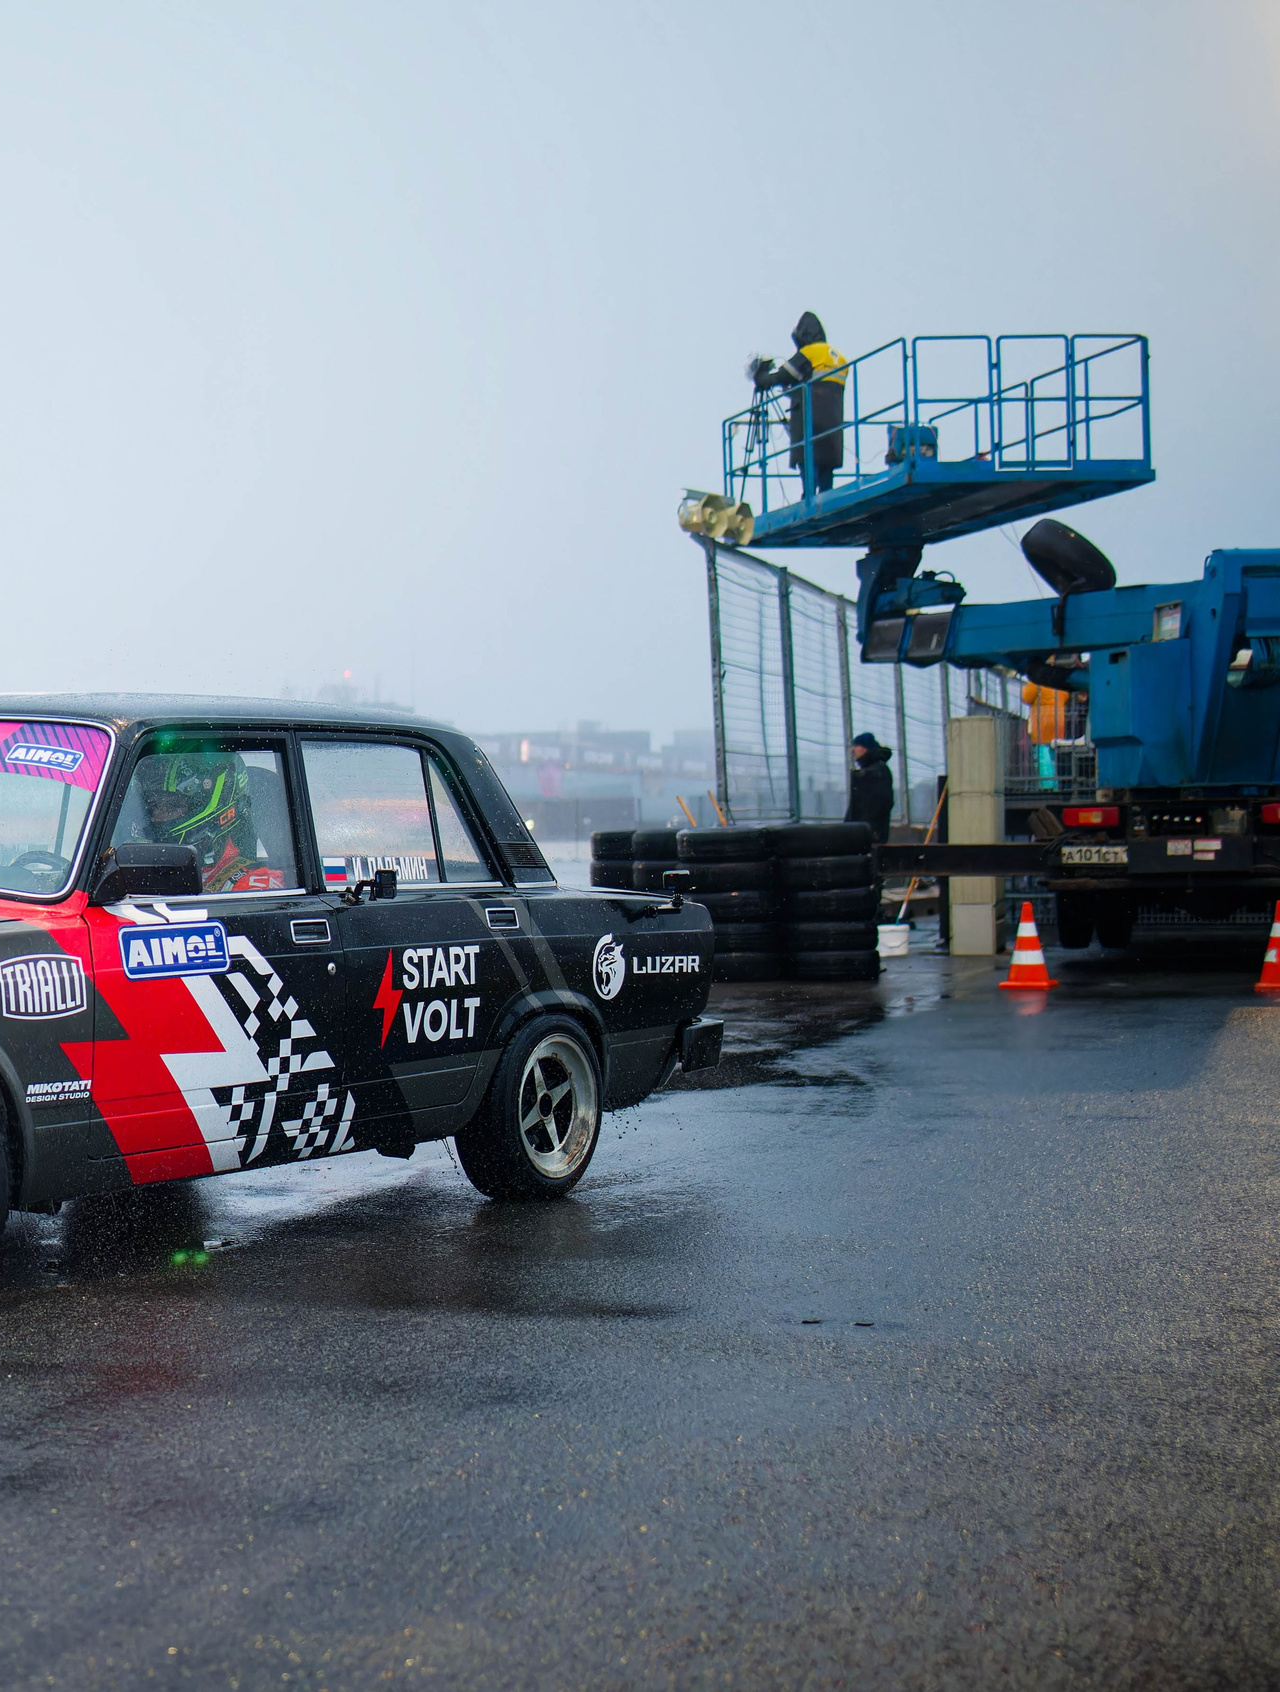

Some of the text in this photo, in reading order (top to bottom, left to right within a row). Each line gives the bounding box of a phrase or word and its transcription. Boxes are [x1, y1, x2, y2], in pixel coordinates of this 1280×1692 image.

[9, 748, 74, 768] AIMOL
[128, 935, 224, 968] AIMOL
[633, 955, 700, 974] LUZAR
[402, 945, 480, 990] START
[3, 960, 81, 1013] TRIALLI
[402, 997, 480, 1043] VOLT
[25, 1091, 89, 1103] DESIGN STUDIO
[27, 1080, 91, 1094] MIKOTATI
